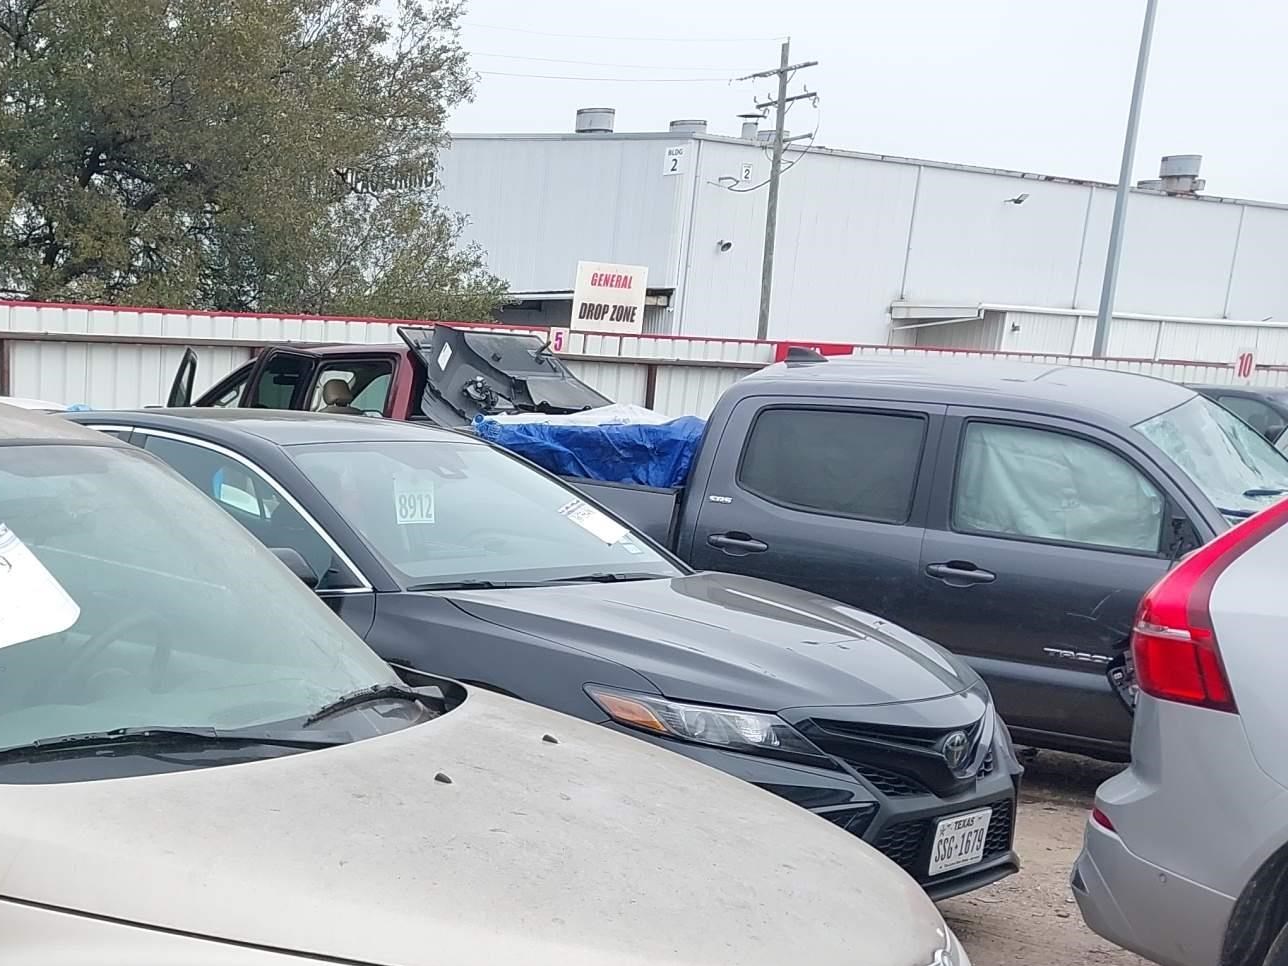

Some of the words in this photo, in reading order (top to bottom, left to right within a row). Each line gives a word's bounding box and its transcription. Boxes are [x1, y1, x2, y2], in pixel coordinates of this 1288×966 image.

[668, 148, 683, 156] BLDG
[670, 158, 678, 172] 2
[744, 168, 751, 179] 2
[590, 272, 633, 289] GENERAL
[578, 302, 609, 321] DROP
[609, 305, 638, 323] ZONE
[554, 332, 563, 352] 5
[1238, 353, 1253, 377] 10
[398, 494, 433, 519] 8912
[954, 816, 975, 831] TEXAS
